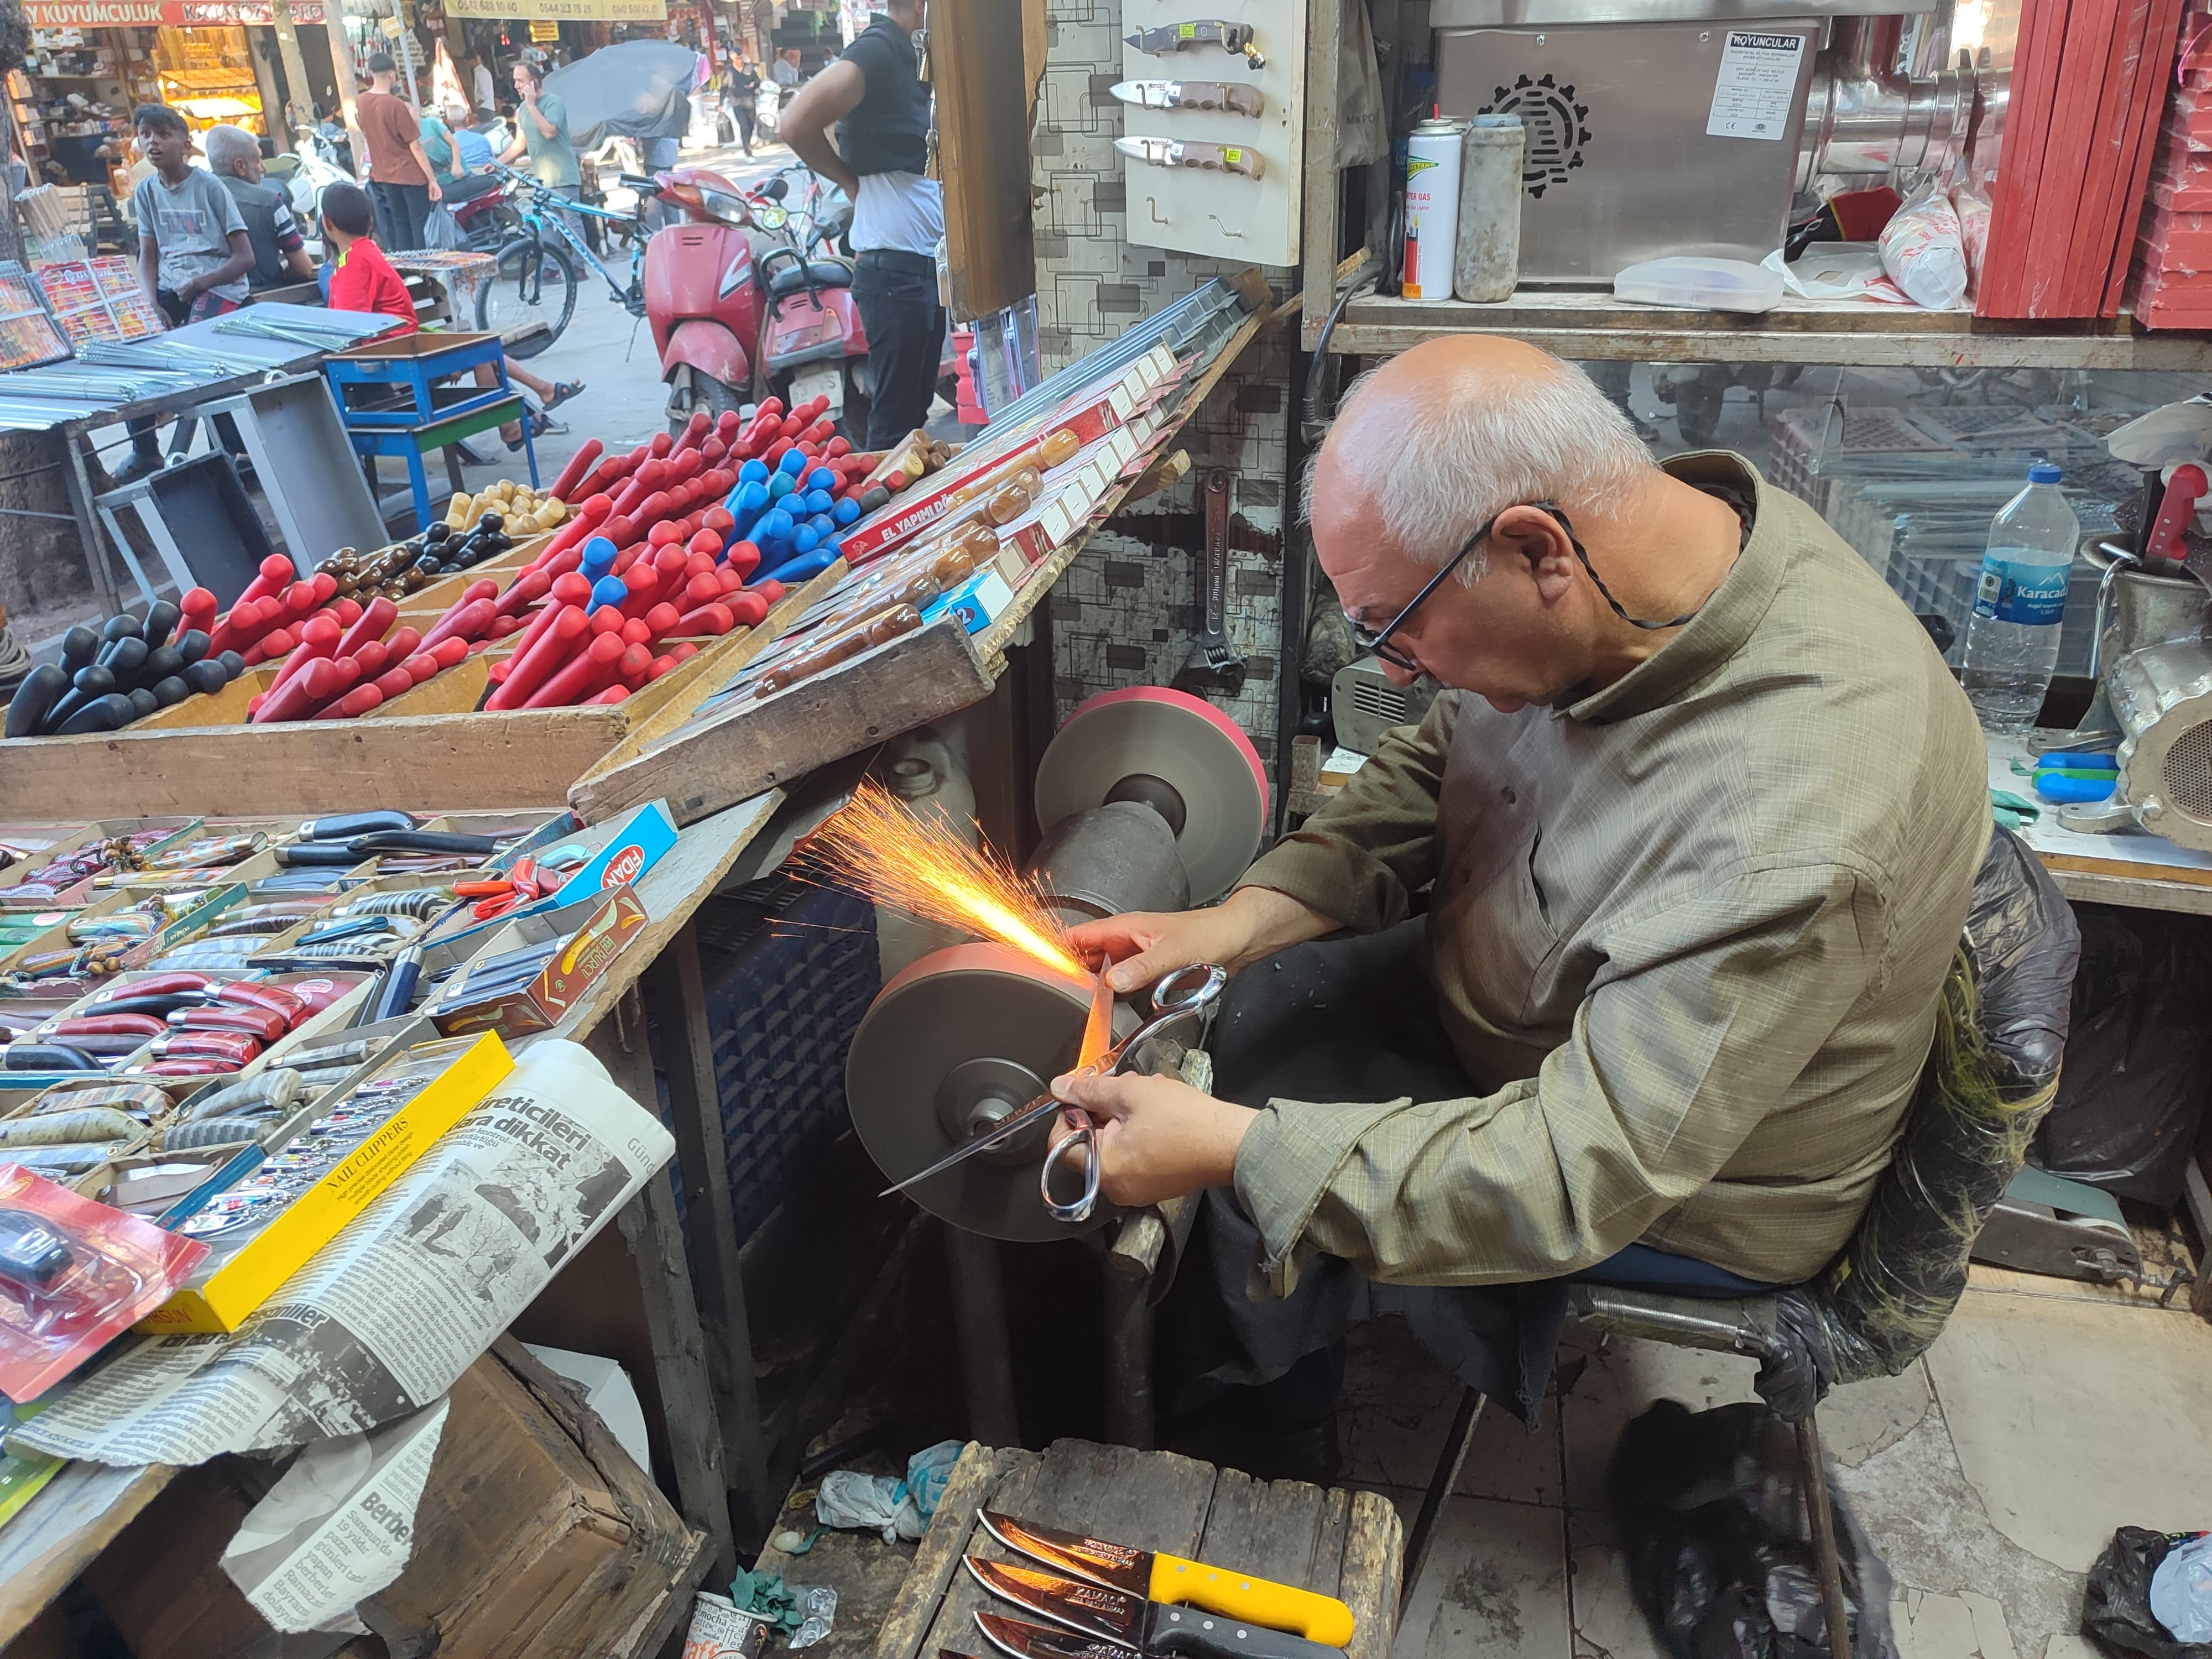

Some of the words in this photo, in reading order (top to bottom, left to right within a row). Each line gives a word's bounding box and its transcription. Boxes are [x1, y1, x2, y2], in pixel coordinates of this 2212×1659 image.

[42, 4, 164, 23] KUYUMCULUK
[1733, 34, 1797, 49] KOYUNCULAR
[881, 526, 897, 542] EL
[895, 508, 935, 531] YAPIMI
[605, 849, 642, 888] FİDAN
[581, 949, 608, 979] BURCU
[471, 1094, 592, 1152] üreticileri
[326, 1166, 358, 1193] NAIL
[355, 1117, 408, 1167] CLIPPERS
[493, 1117, 573, 1171] dikkat
[336, 1519, 350, 1532] 19
[346, 1510, 393, 1557] Samsun'da
[314, 1540, 348, 1574] günleri
[324, 1530, 352, 1556] pazar
[304, 1550, 334, 1580] yapan
[700, 1610, 728, 1627] mocha
